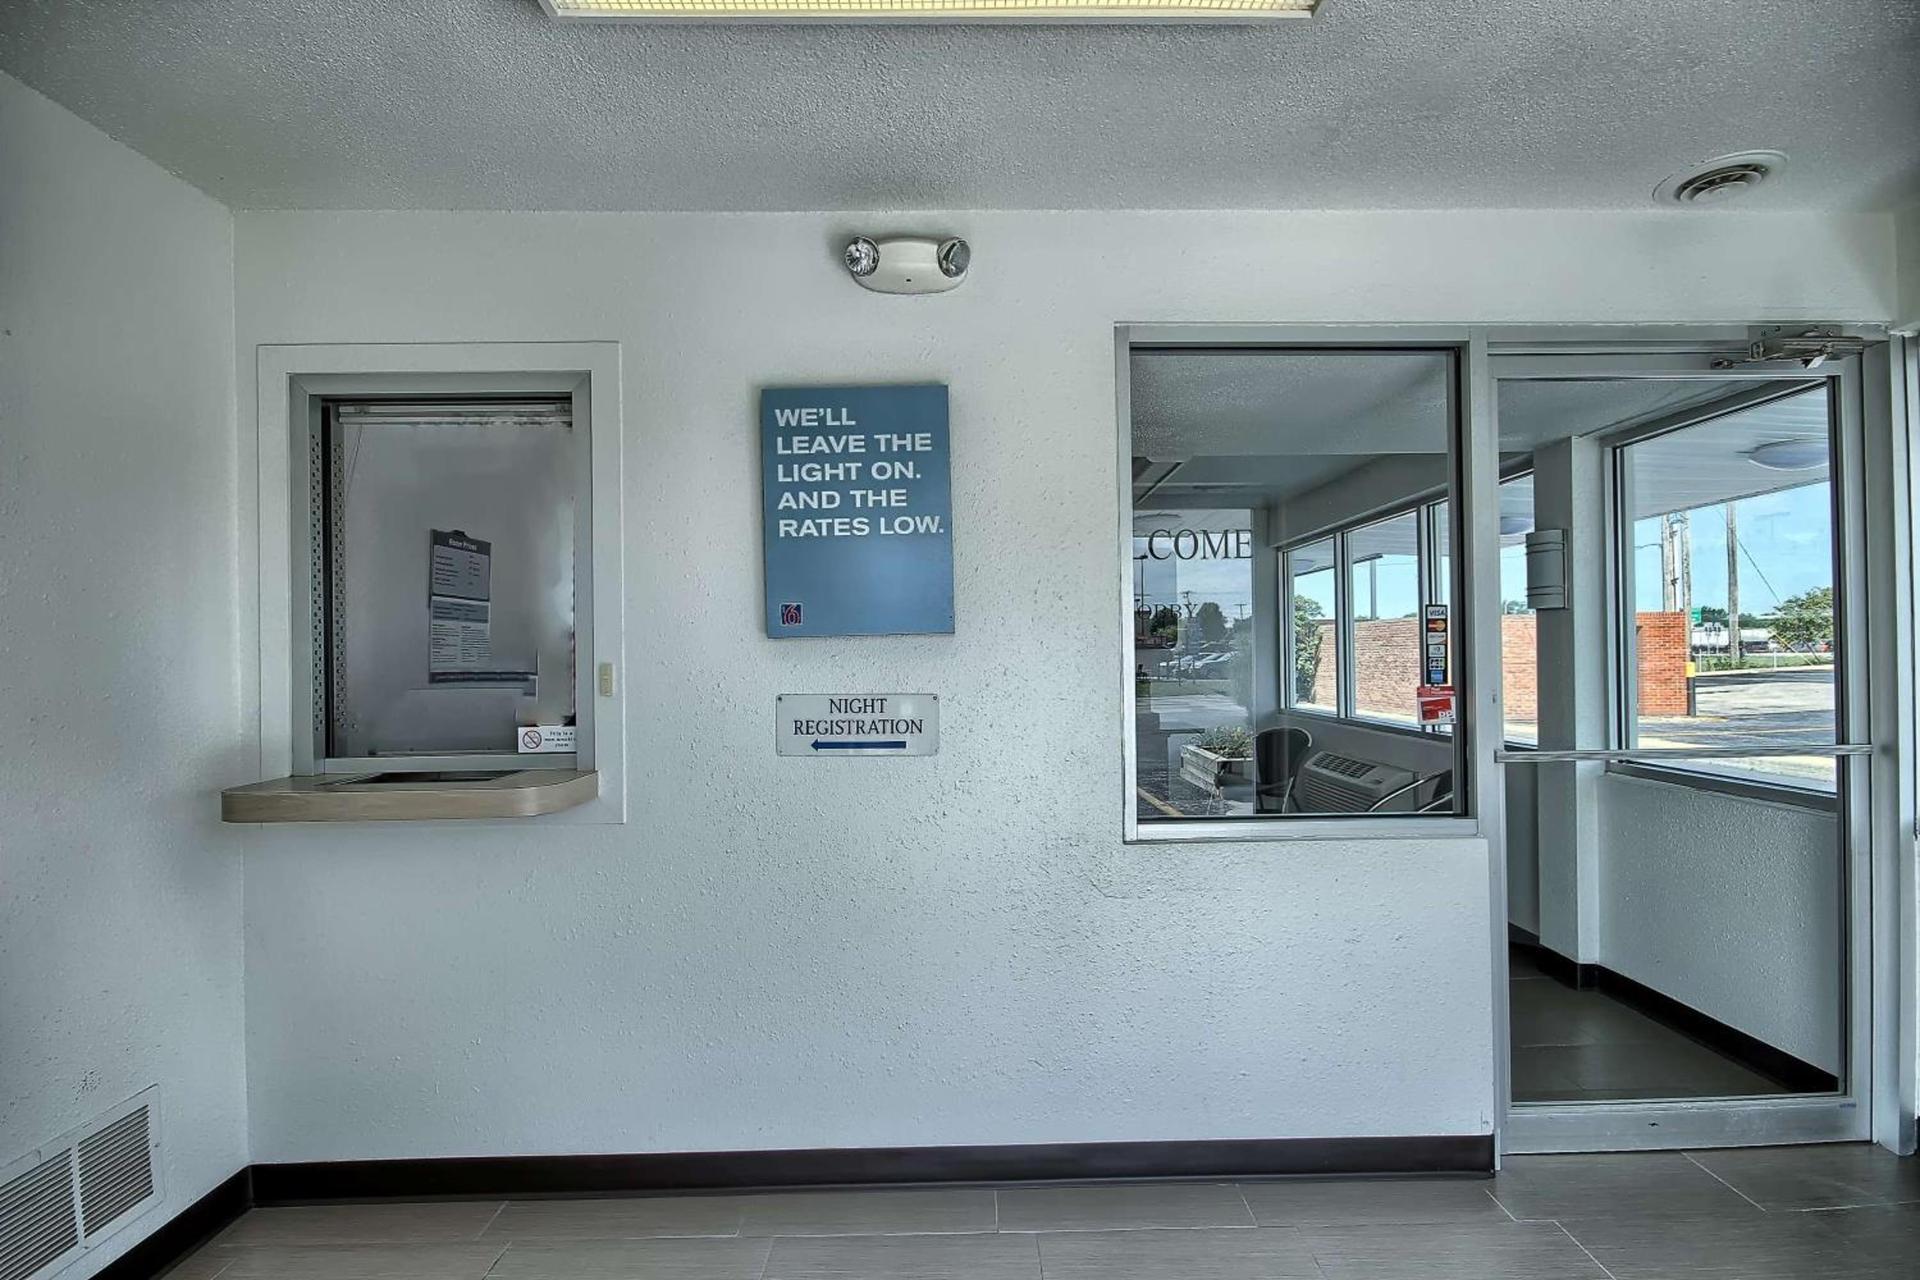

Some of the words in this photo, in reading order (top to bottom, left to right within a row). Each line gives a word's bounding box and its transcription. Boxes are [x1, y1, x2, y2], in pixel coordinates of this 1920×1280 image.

[774, 407, 856, 427] WE'LL
[776, 434, 866, 455] LEAVE
[873, 432, 933, 452] THE
[777, 462, 863, 482] LIGHT
[870, 460, 921, 481] ON.
[777, 490, 841, 510] AND
[849, 488, 908, 508] THE
[778, 517, 870, 538] RATES
[879, 515, 944, 535] LOW.
[1429, 608, 1446, 617] VISA
[829, 697, 888, 714] NIGHT
[793, 718, 923, 736] REGISTRATION
